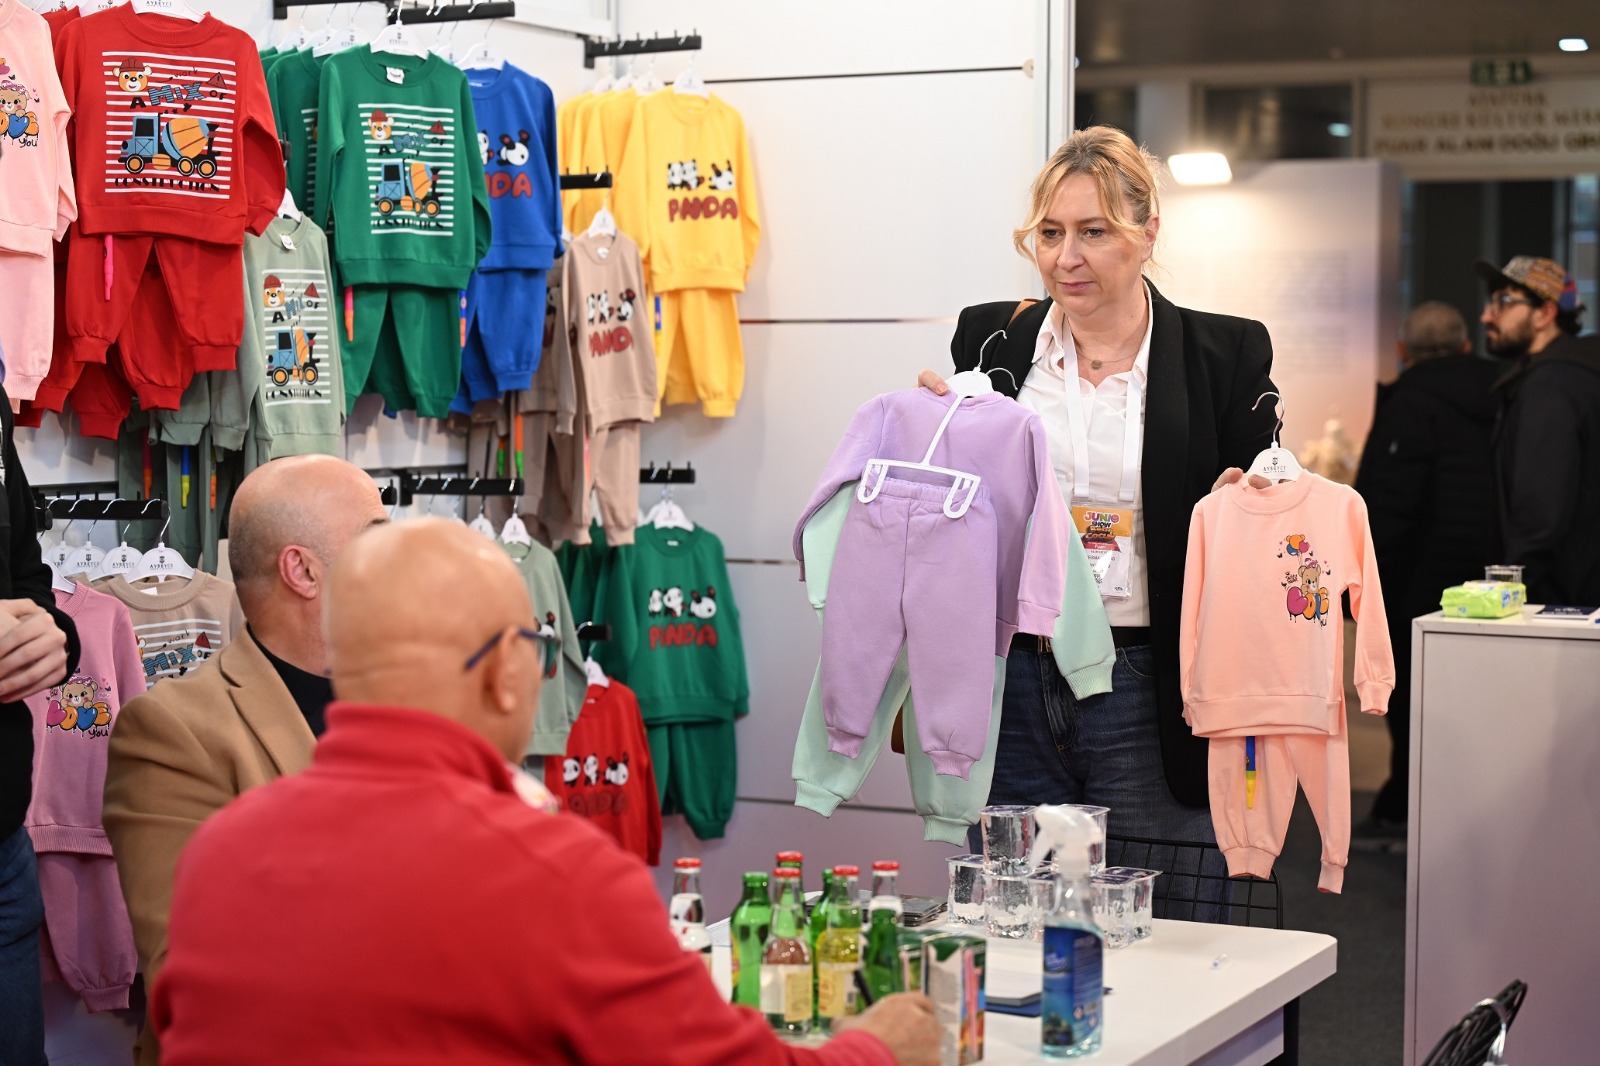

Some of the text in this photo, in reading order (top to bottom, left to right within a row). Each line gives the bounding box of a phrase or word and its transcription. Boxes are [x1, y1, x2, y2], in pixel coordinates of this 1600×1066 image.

[130, 82, 227, 108] A MIX OF
[378, 146, 392, 156] A
[272, 311, 285, 324] A
[142, 643, 198, 676] MIX
